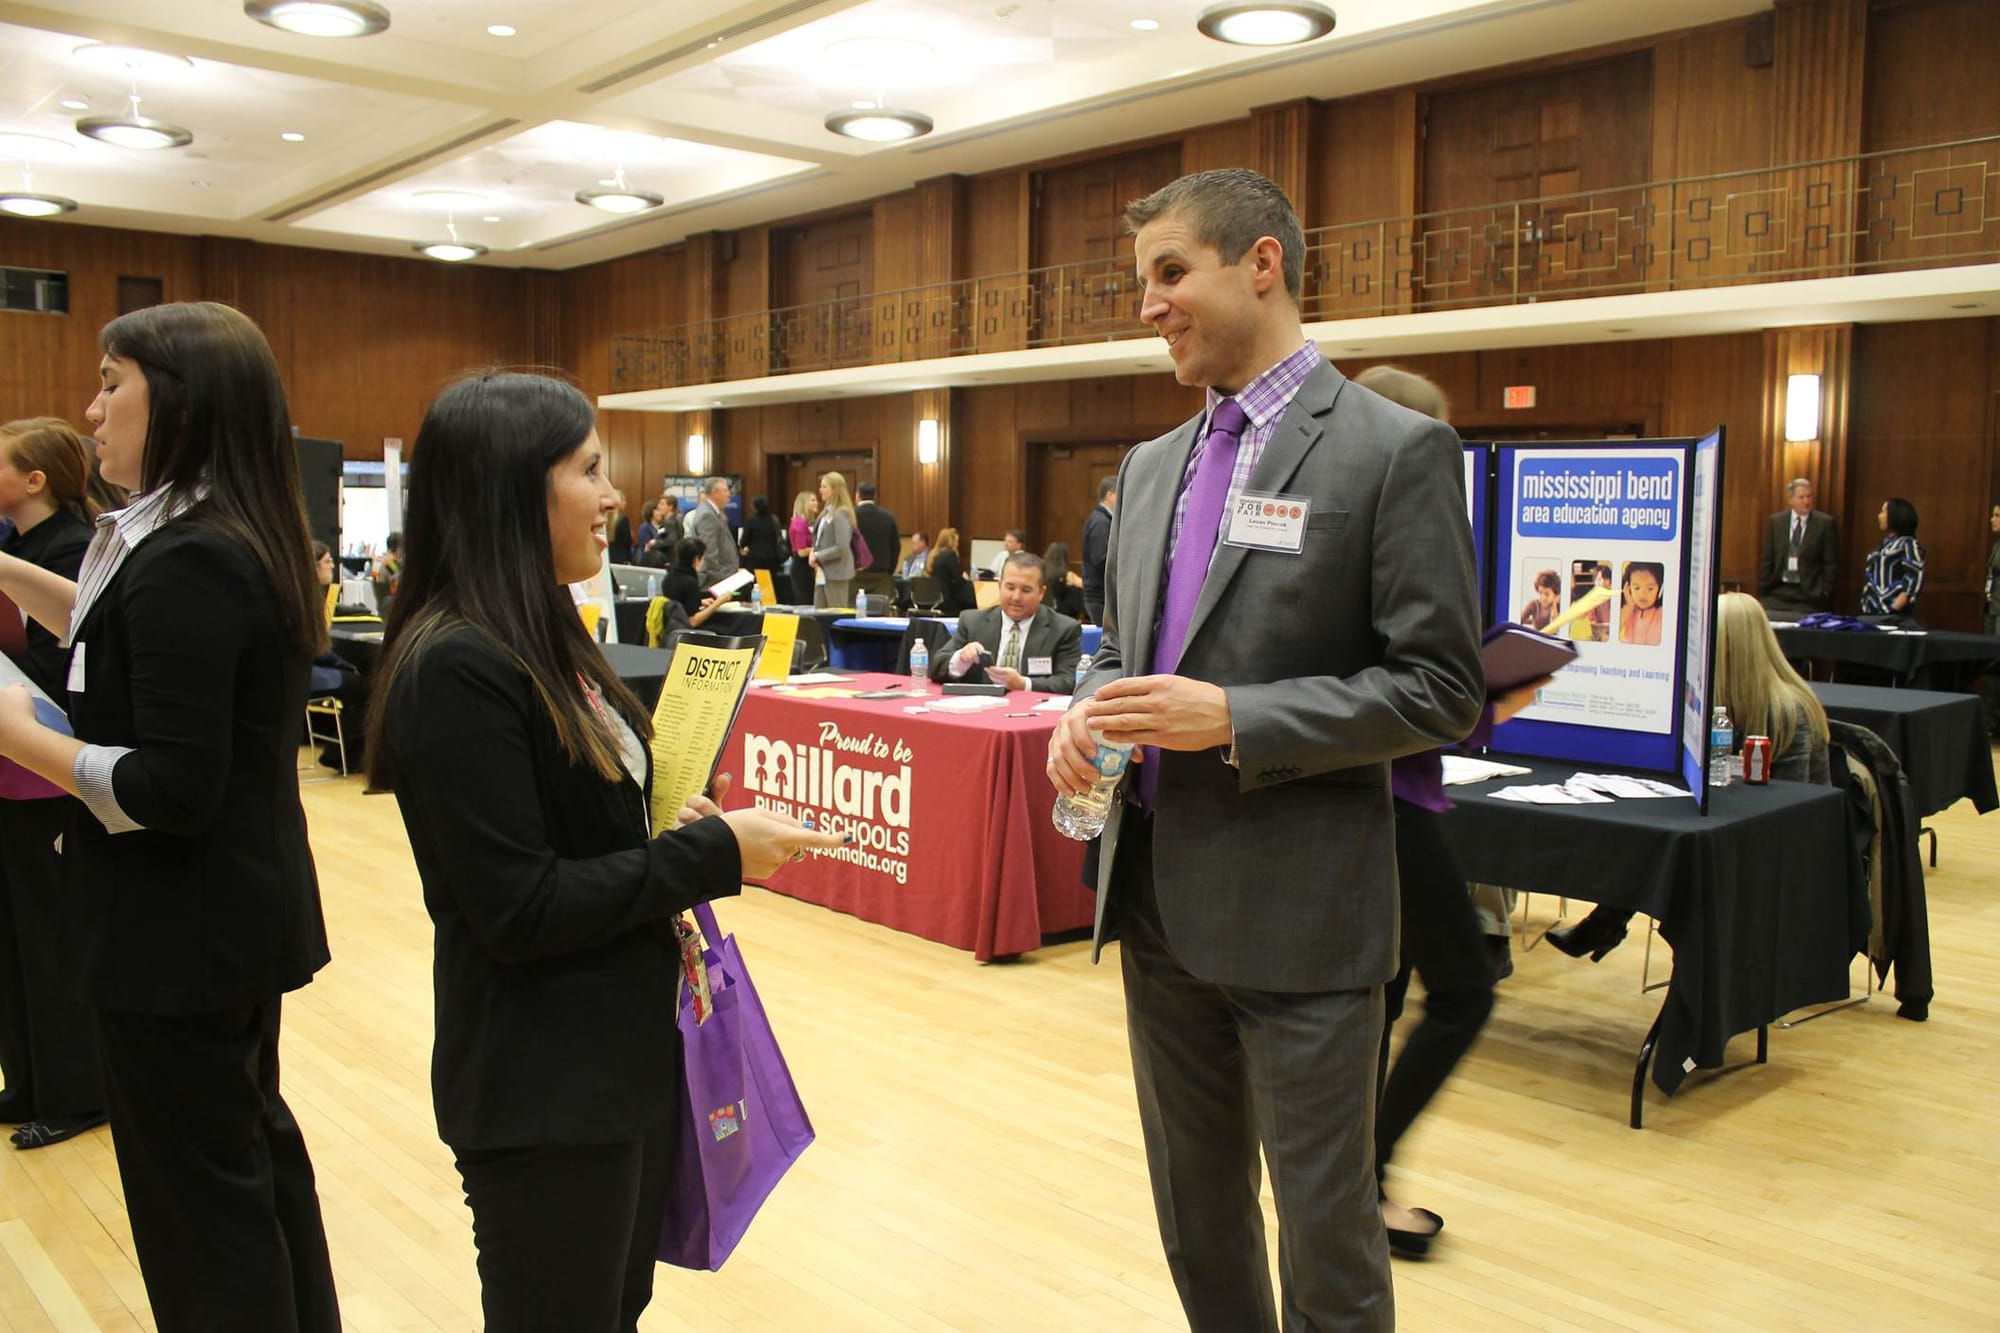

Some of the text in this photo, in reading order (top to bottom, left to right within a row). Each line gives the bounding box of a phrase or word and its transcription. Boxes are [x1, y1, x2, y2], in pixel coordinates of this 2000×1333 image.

[1522, 470, 1673, 504] mississippi bend
[1522, 503, 1670, 530] area education agency
[685, 656, 741, 681] DISTRICT
[1628, 668, 1640, 678] and
[818, 721, 914, 763] Proud to be
[743, 732, 912, 828] millard
[819, 812, 910, 857] SCHOOLS
